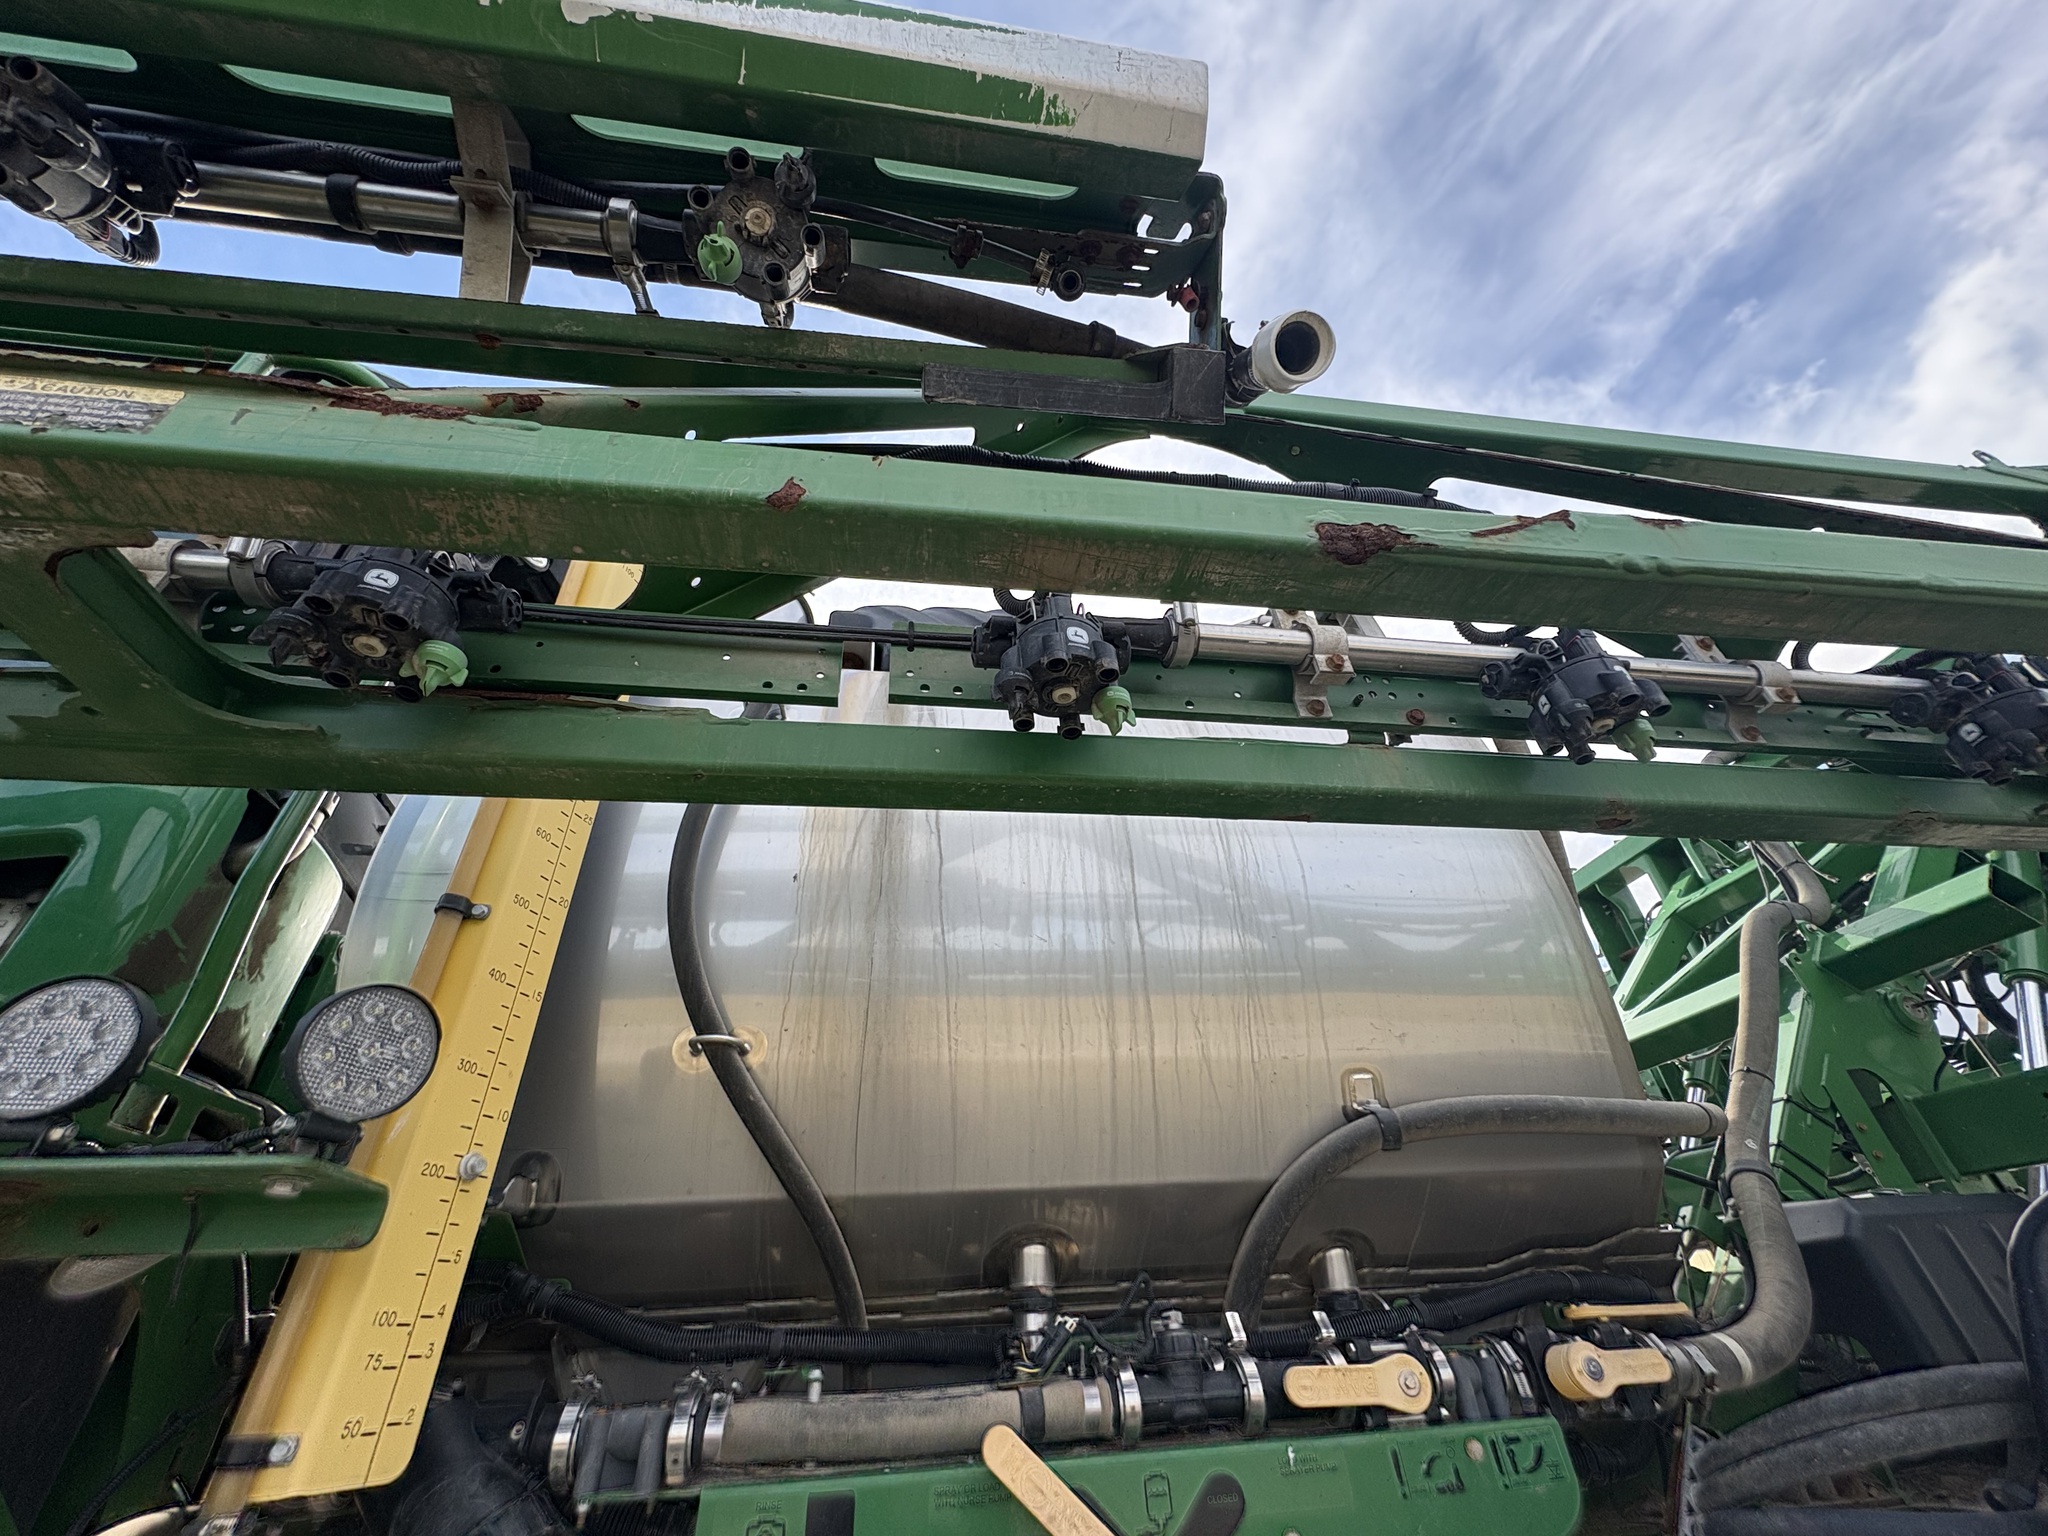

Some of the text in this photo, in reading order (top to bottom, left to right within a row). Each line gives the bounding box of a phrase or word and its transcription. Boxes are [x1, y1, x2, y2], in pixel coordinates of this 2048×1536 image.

[41, 384, 134, 399] CAUTION
[582, 813, 594, 826] 25
[535, 827, 552, 842] 600
[513, 894, 530, 910] 500
[558, 896, 569, 909] 20
[488, 968, 507, 984] 400
[532, 990, 543, 1003] 15
[457, 1058, 478, 1074] 300
[497, 1110, 510, 1123] 10
[421, 1162, 445, 1179] 200
[453, 1249, 462, 1263] 5
[372, 1310, 398, 1327] 100
[437, 1304, 446, 1319] 4
[424, 1344, 435, 1360] 3
[364, 1354, 383, 1371] 75
[403, 1408, 417, 1426] 2
[340, 1420, 363, 1439] 50
[1277, 1455, 1298, 1466] LOD
[934, 1481, 1001, 1496] SPRAY OR LOAD
[756, 1500, 782, 1511] RINSE
[1207, 1492, 1239, 1504] CLOSED
